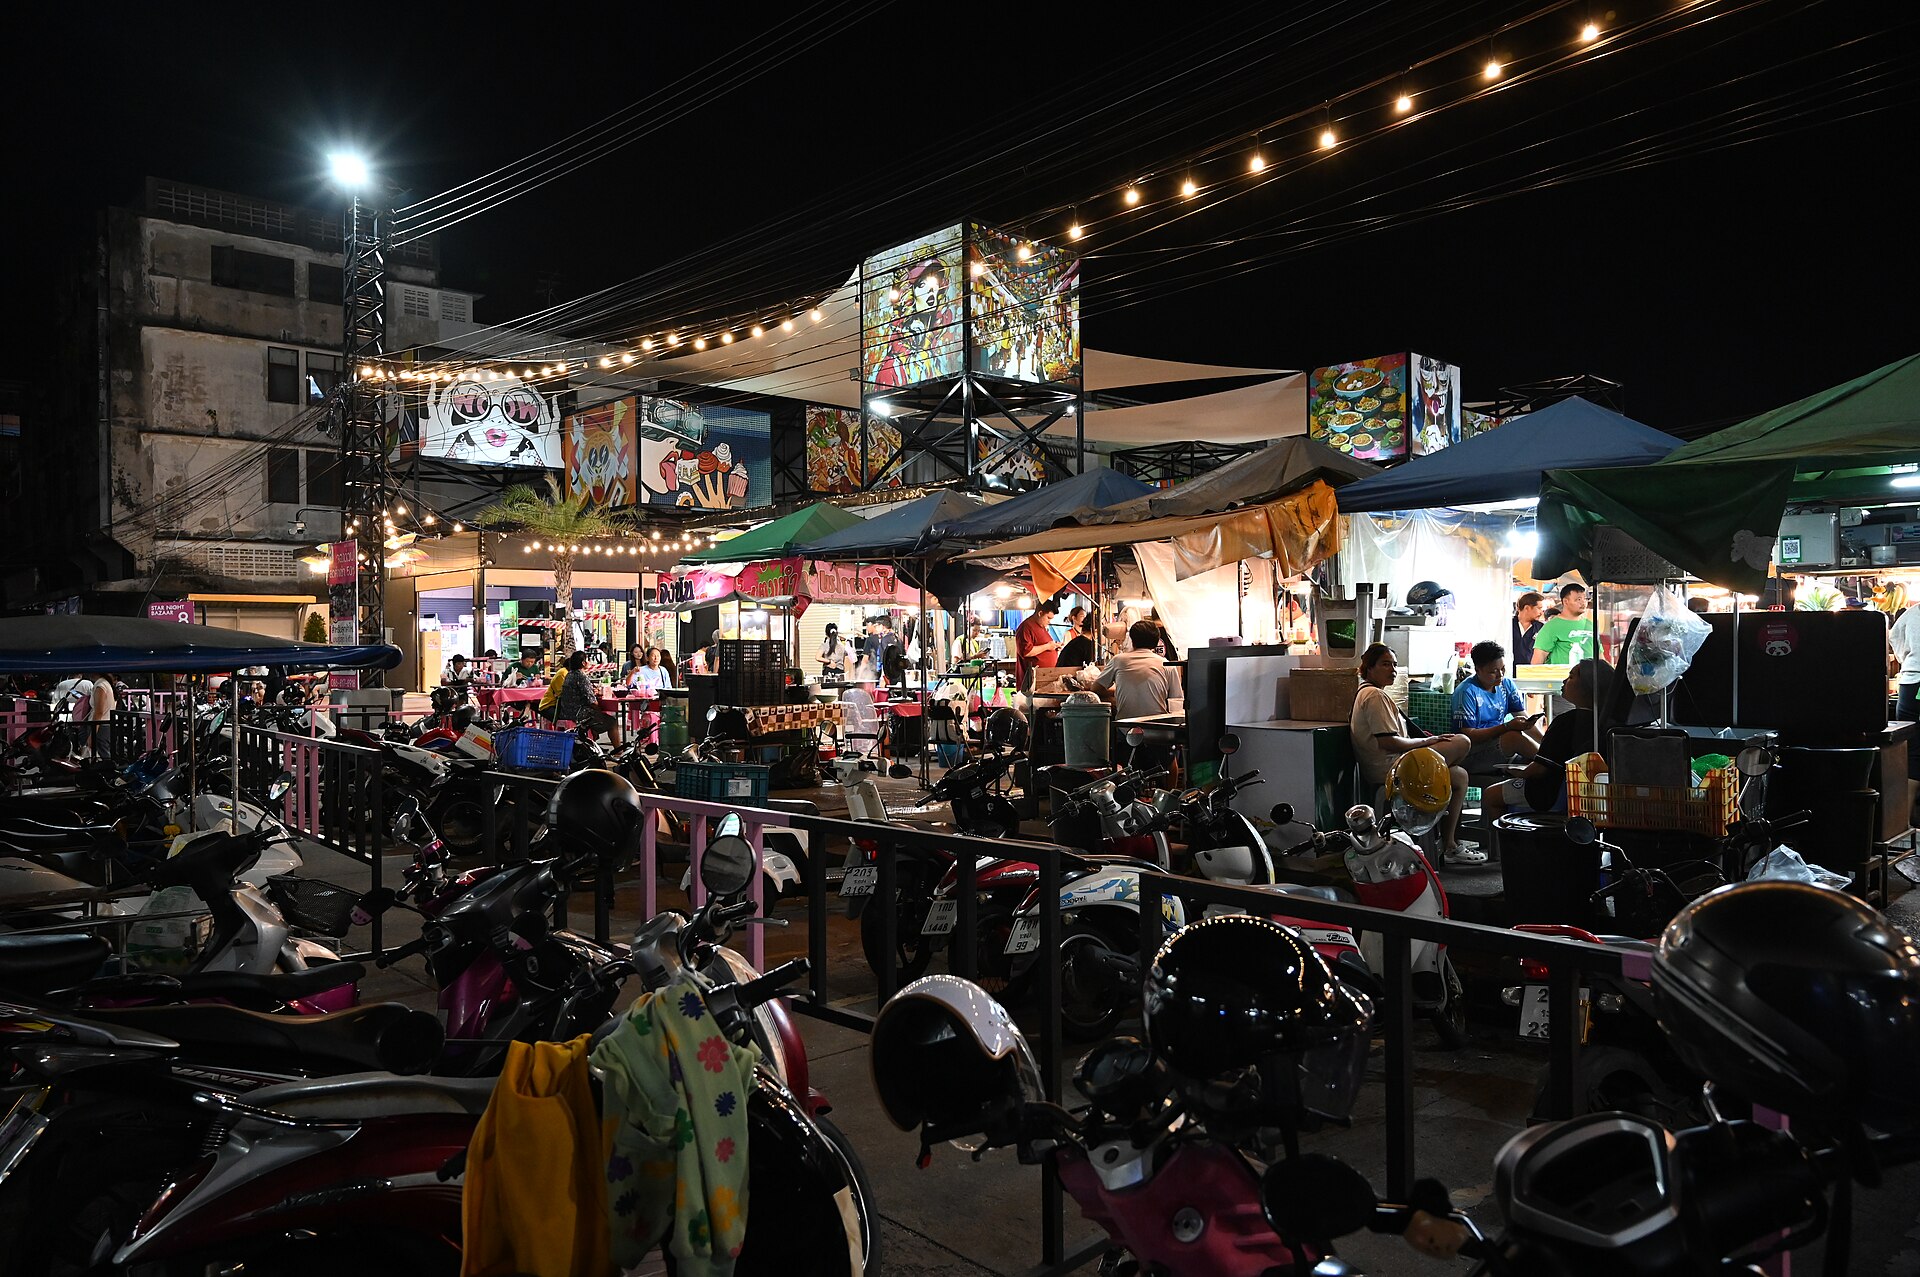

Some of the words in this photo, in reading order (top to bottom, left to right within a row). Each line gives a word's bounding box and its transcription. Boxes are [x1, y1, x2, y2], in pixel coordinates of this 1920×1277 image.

[845, 885, 872, 895] 3167
[1015, 941, 1028, 951] 99
[1528, 1021, 1550, 1036] 23
